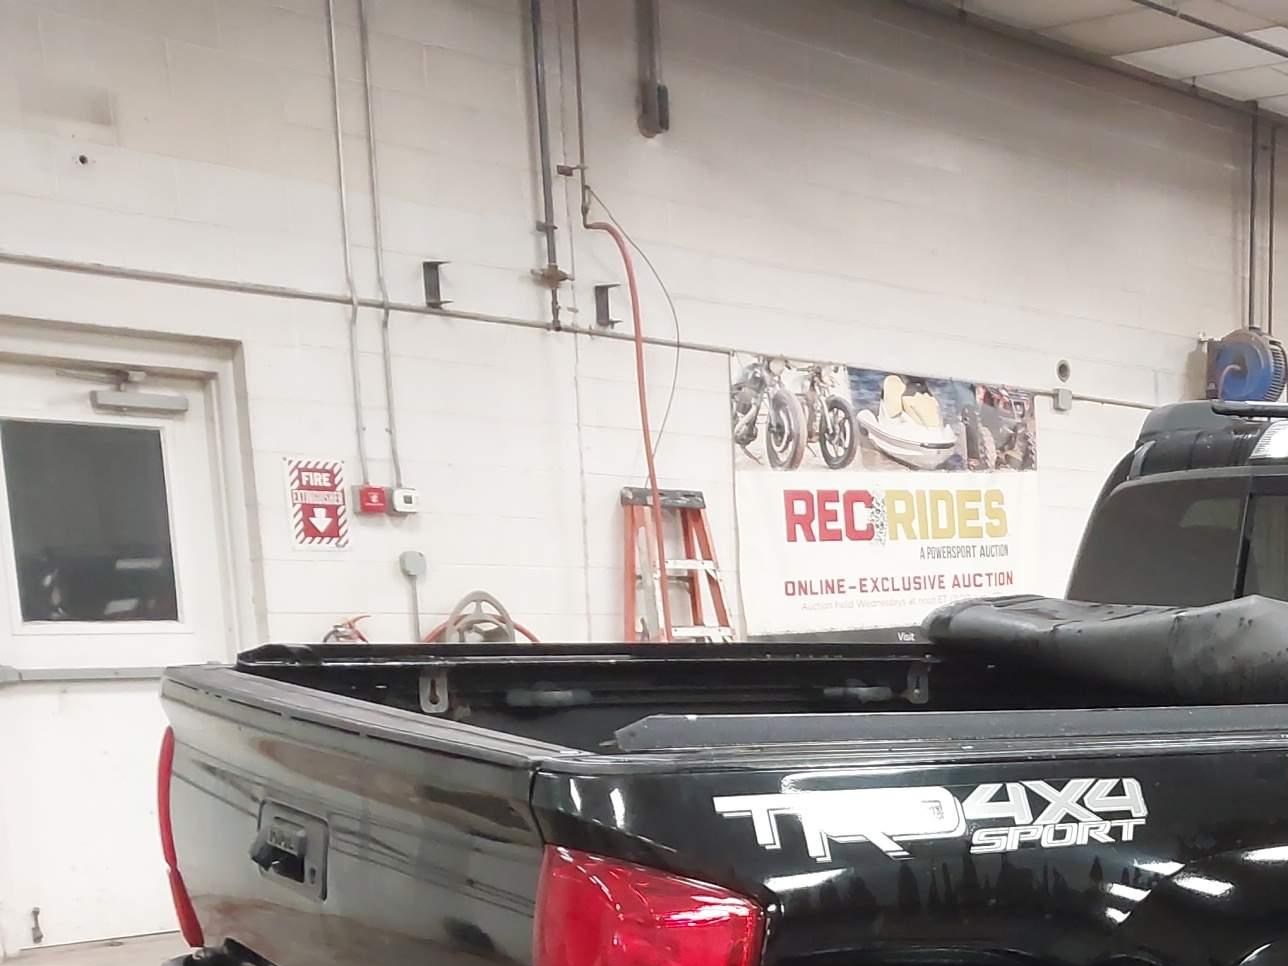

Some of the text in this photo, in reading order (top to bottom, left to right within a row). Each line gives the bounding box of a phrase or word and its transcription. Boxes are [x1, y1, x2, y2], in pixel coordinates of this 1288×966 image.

[300, 471, 332, 487] FIRE
[783, 489, 1009, 542] REC RIDES
[920, 544, 1009, 560] A POWERSPORT AUCTION
[951, 571, 1014, 589] AUCTION
[897, 632, 916, 642] Visit
[713, 777, 1149, 863] TRD 4X4
[970, 818, 1147, 855] SPORT
